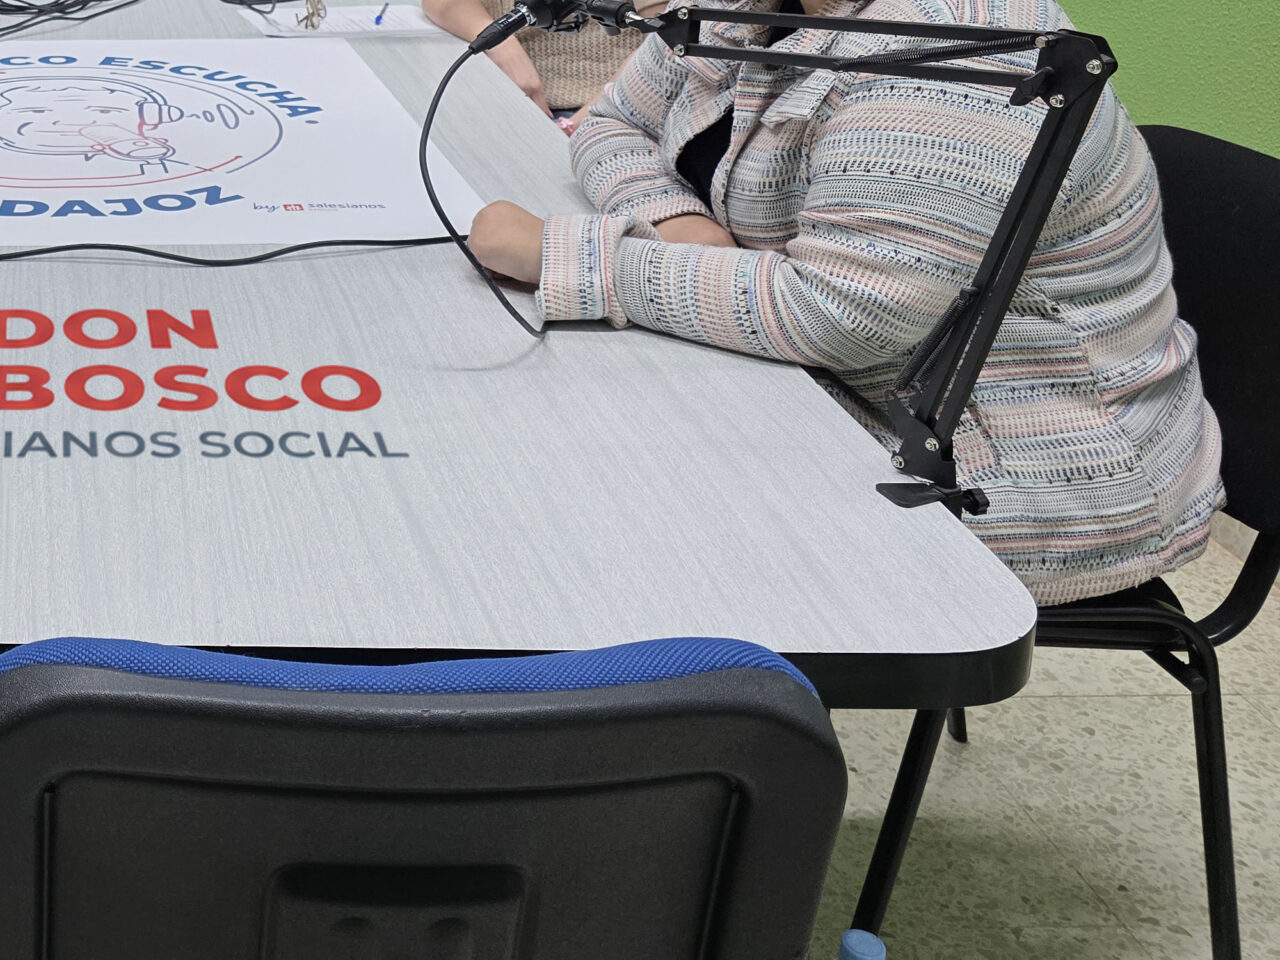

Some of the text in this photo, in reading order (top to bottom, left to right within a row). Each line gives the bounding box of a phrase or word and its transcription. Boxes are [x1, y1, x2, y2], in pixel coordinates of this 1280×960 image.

[98, 55, 324, 117] ESCUCHA
[252, 201, 387, 213] by salesianos
[199, 431, 410, 458] SOCIAL
